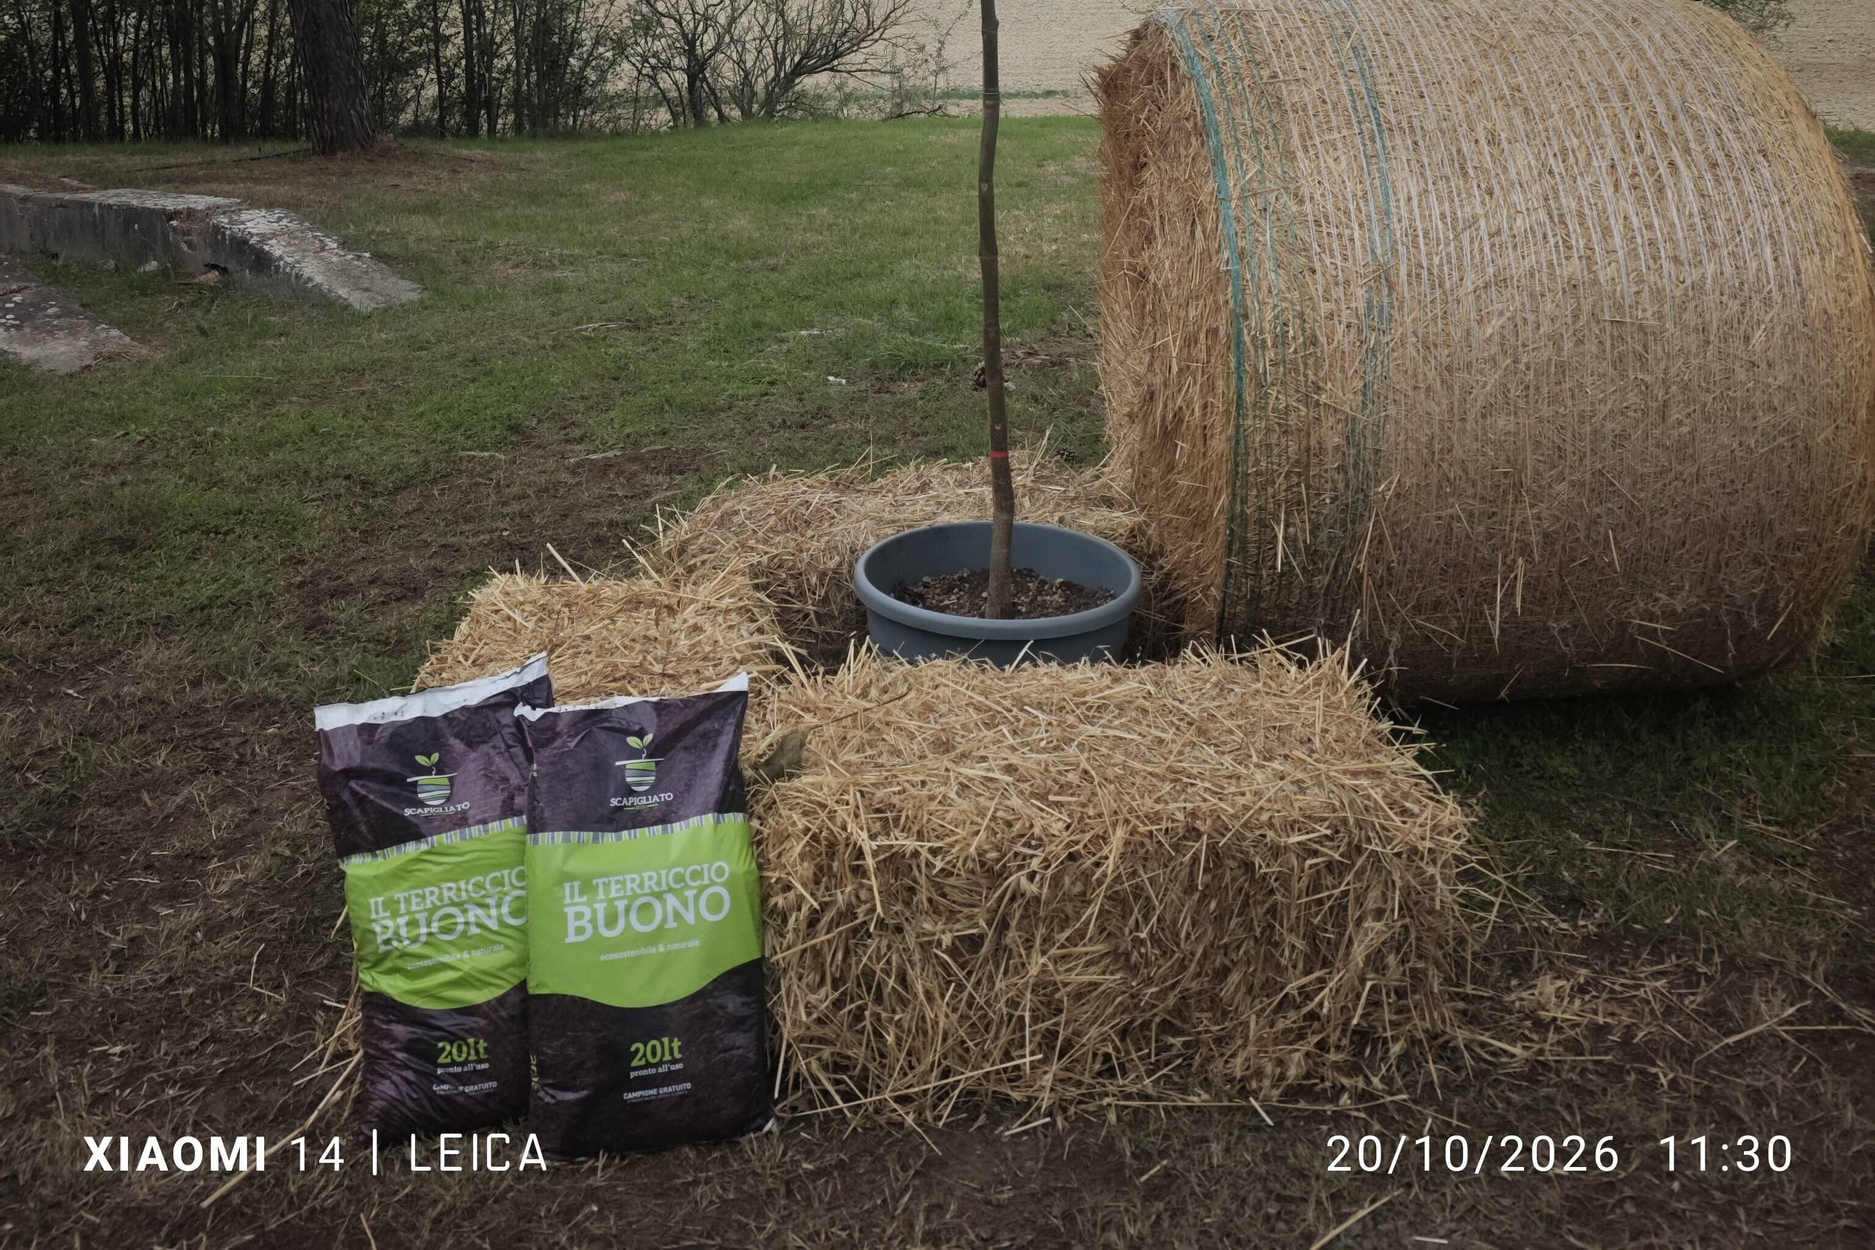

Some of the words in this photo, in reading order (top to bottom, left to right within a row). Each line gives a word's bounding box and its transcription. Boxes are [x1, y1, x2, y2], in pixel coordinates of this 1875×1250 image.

[609, 792, 674, 807] SCAPIGLIATO
[403, 801, 471, 817] SCAPIGLIATO
[563, 881, 588, 904] IL
[592, 861, 730, 900] TERRICCIO
[368, 896, 391, 920] IL
[563, 885, 731, 943] BUONO
[462, 950, 470, 958] &
[471, 944, 505, 956] naturale
[600, 946, 657, 961] ecosostenibile
[658, 943, 666, 953] &
[667, 938, 700, 951] naturale
[436, 1037, 489, 1064] 20lt
[630, 1036, 682, 1067] 20lt
[436, 1066, 462, 1075] pronto
[463, 1062, 490, 1072] all'uso
[629, 1069, 657, 1079] pronto
[657, 1063, 684, 1073] all'uso
[464, 1081, 498, 1093] GRATUITO
[623, 1089, 658, 1100] CAMPIONE
[658, 1082, 692, 1094] GRATUITO
